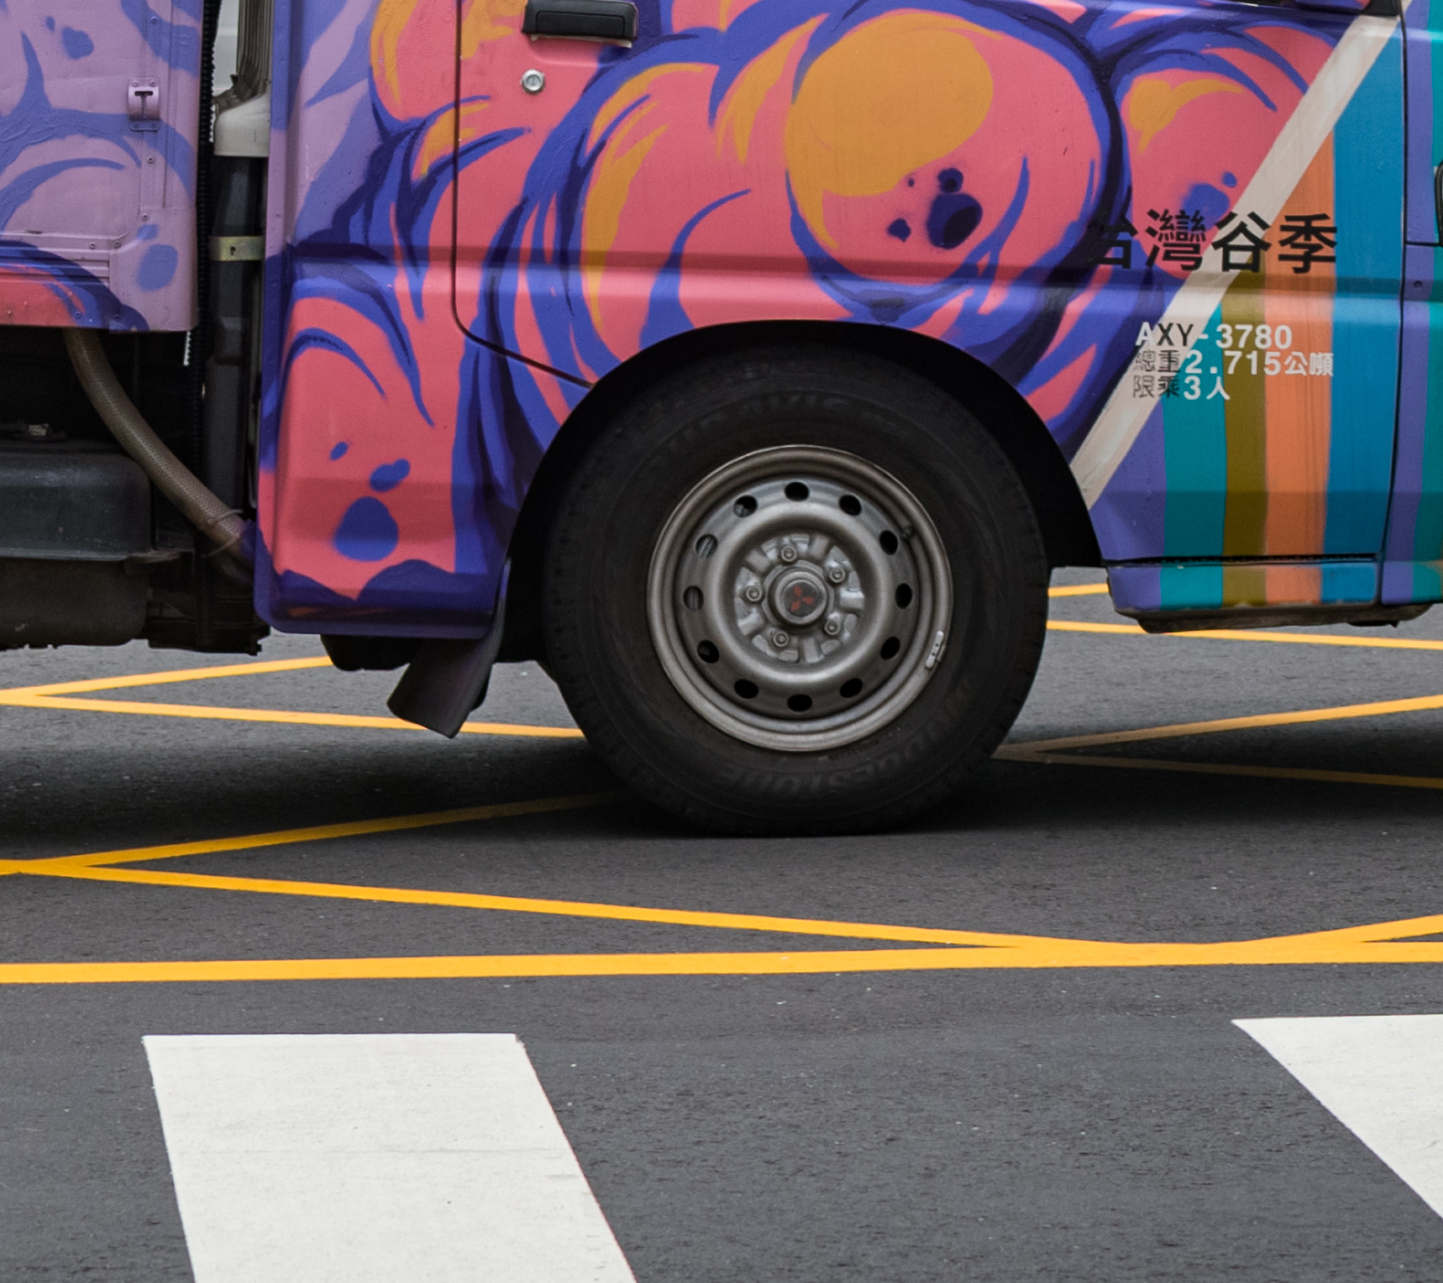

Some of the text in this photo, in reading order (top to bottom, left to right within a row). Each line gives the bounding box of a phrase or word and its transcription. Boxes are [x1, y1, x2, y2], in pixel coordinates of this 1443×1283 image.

[1087, 209, 1338, 274] 台灣谷季
[1135, 322, 1293, 349] AXY-3780
[1133, 375, 1231, 400] 限乘3人
